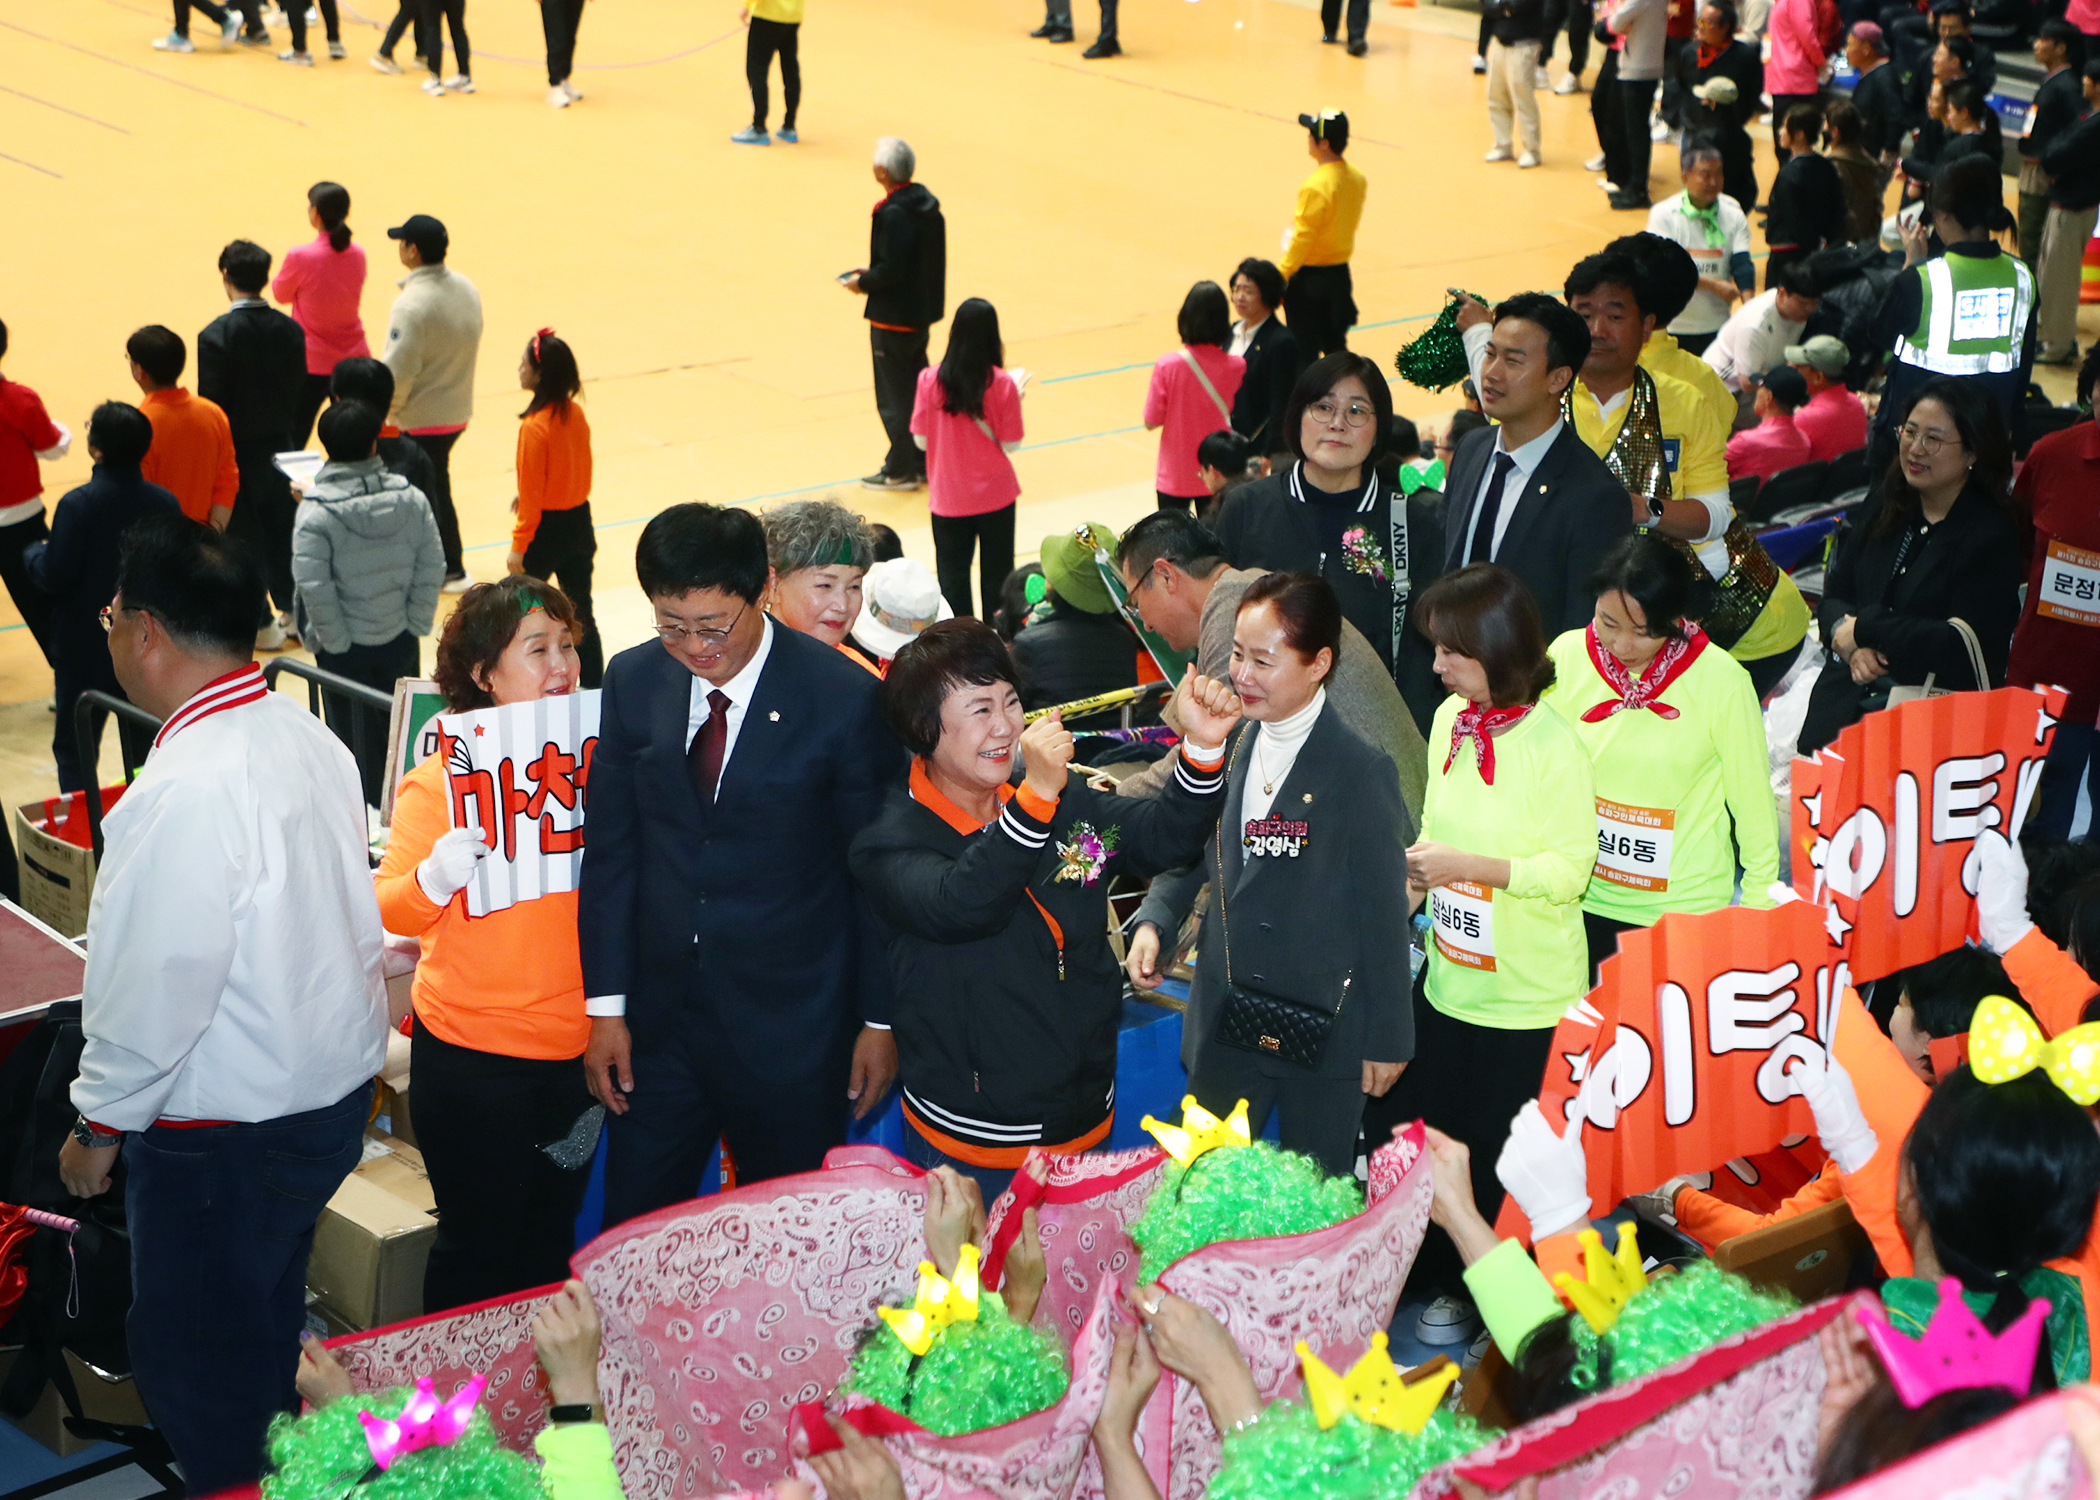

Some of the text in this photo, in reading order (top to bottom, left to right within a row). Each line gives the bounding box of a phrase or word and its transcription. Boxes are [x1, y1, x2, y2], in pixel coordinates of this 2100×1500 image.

[1393, 521, 1407, 571] DKNY
[2077, 557, 2100, 568] 송파구
[1245, 819, 1308, 836] 송파구의원
[1598, 806, 1662, 827] 송파구민체육대회
[1249, 835, 1301, 858] 김영심
[1597, 829, 1656, 863] 실6동
[1432, 892, 1480, 938] 잠실6동
